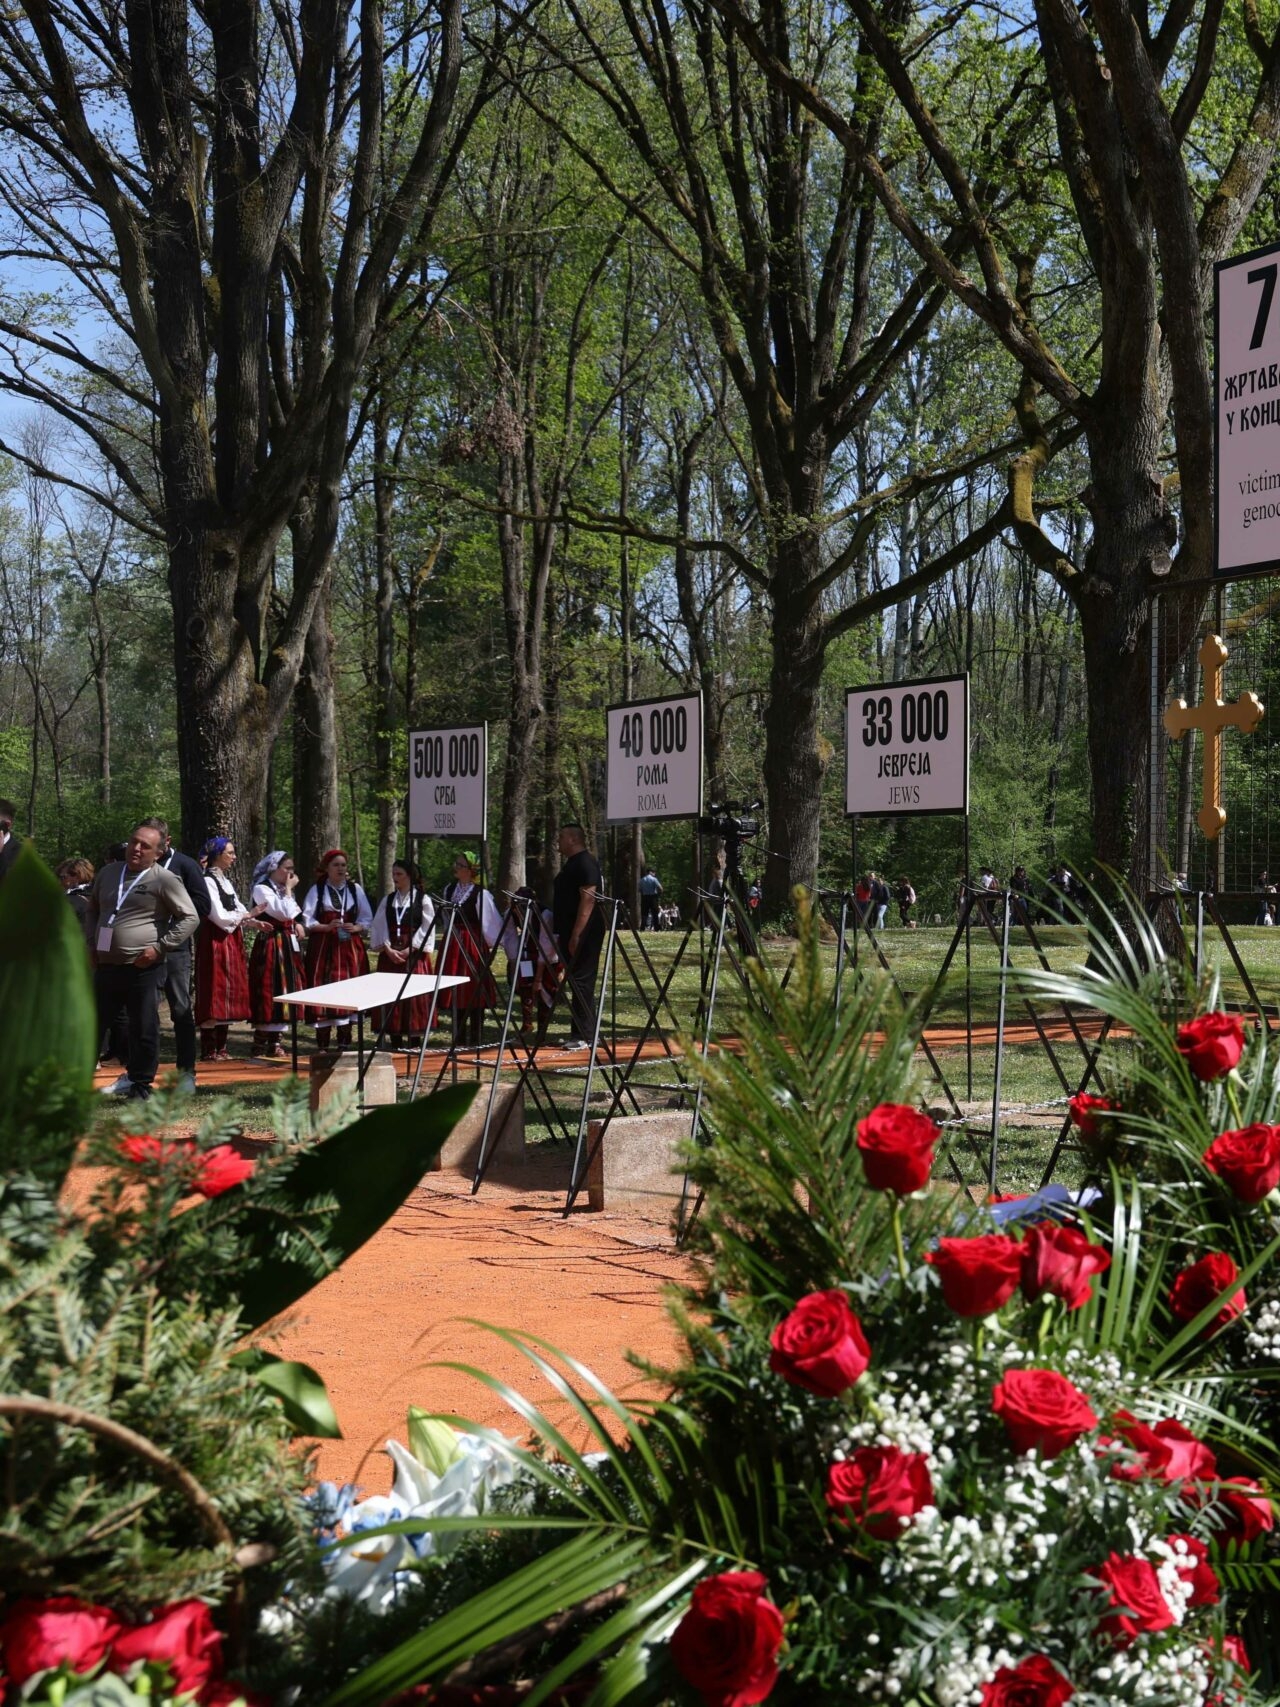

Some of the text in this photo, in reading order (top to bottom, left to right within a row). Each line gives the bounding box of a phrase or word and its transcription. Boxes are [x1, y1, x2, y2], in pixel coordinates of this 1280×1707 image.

[1226, 412, 1235, 435] У
[863, 690, 948, 747] 33 000
[620, 706, 687, 758] 40 000
[414, 734, 478, 778] 500 000
[878, 752, 931, 778] ЈЕВРЕЈА
[637, 763, 668, 786] РОМА
[434, 785, 456, 805] СРБА
[638, 794, 667, 811] ROMA
[888, 786, 920, 805] JEWS
[434, 813, 456, 828] SERBS
